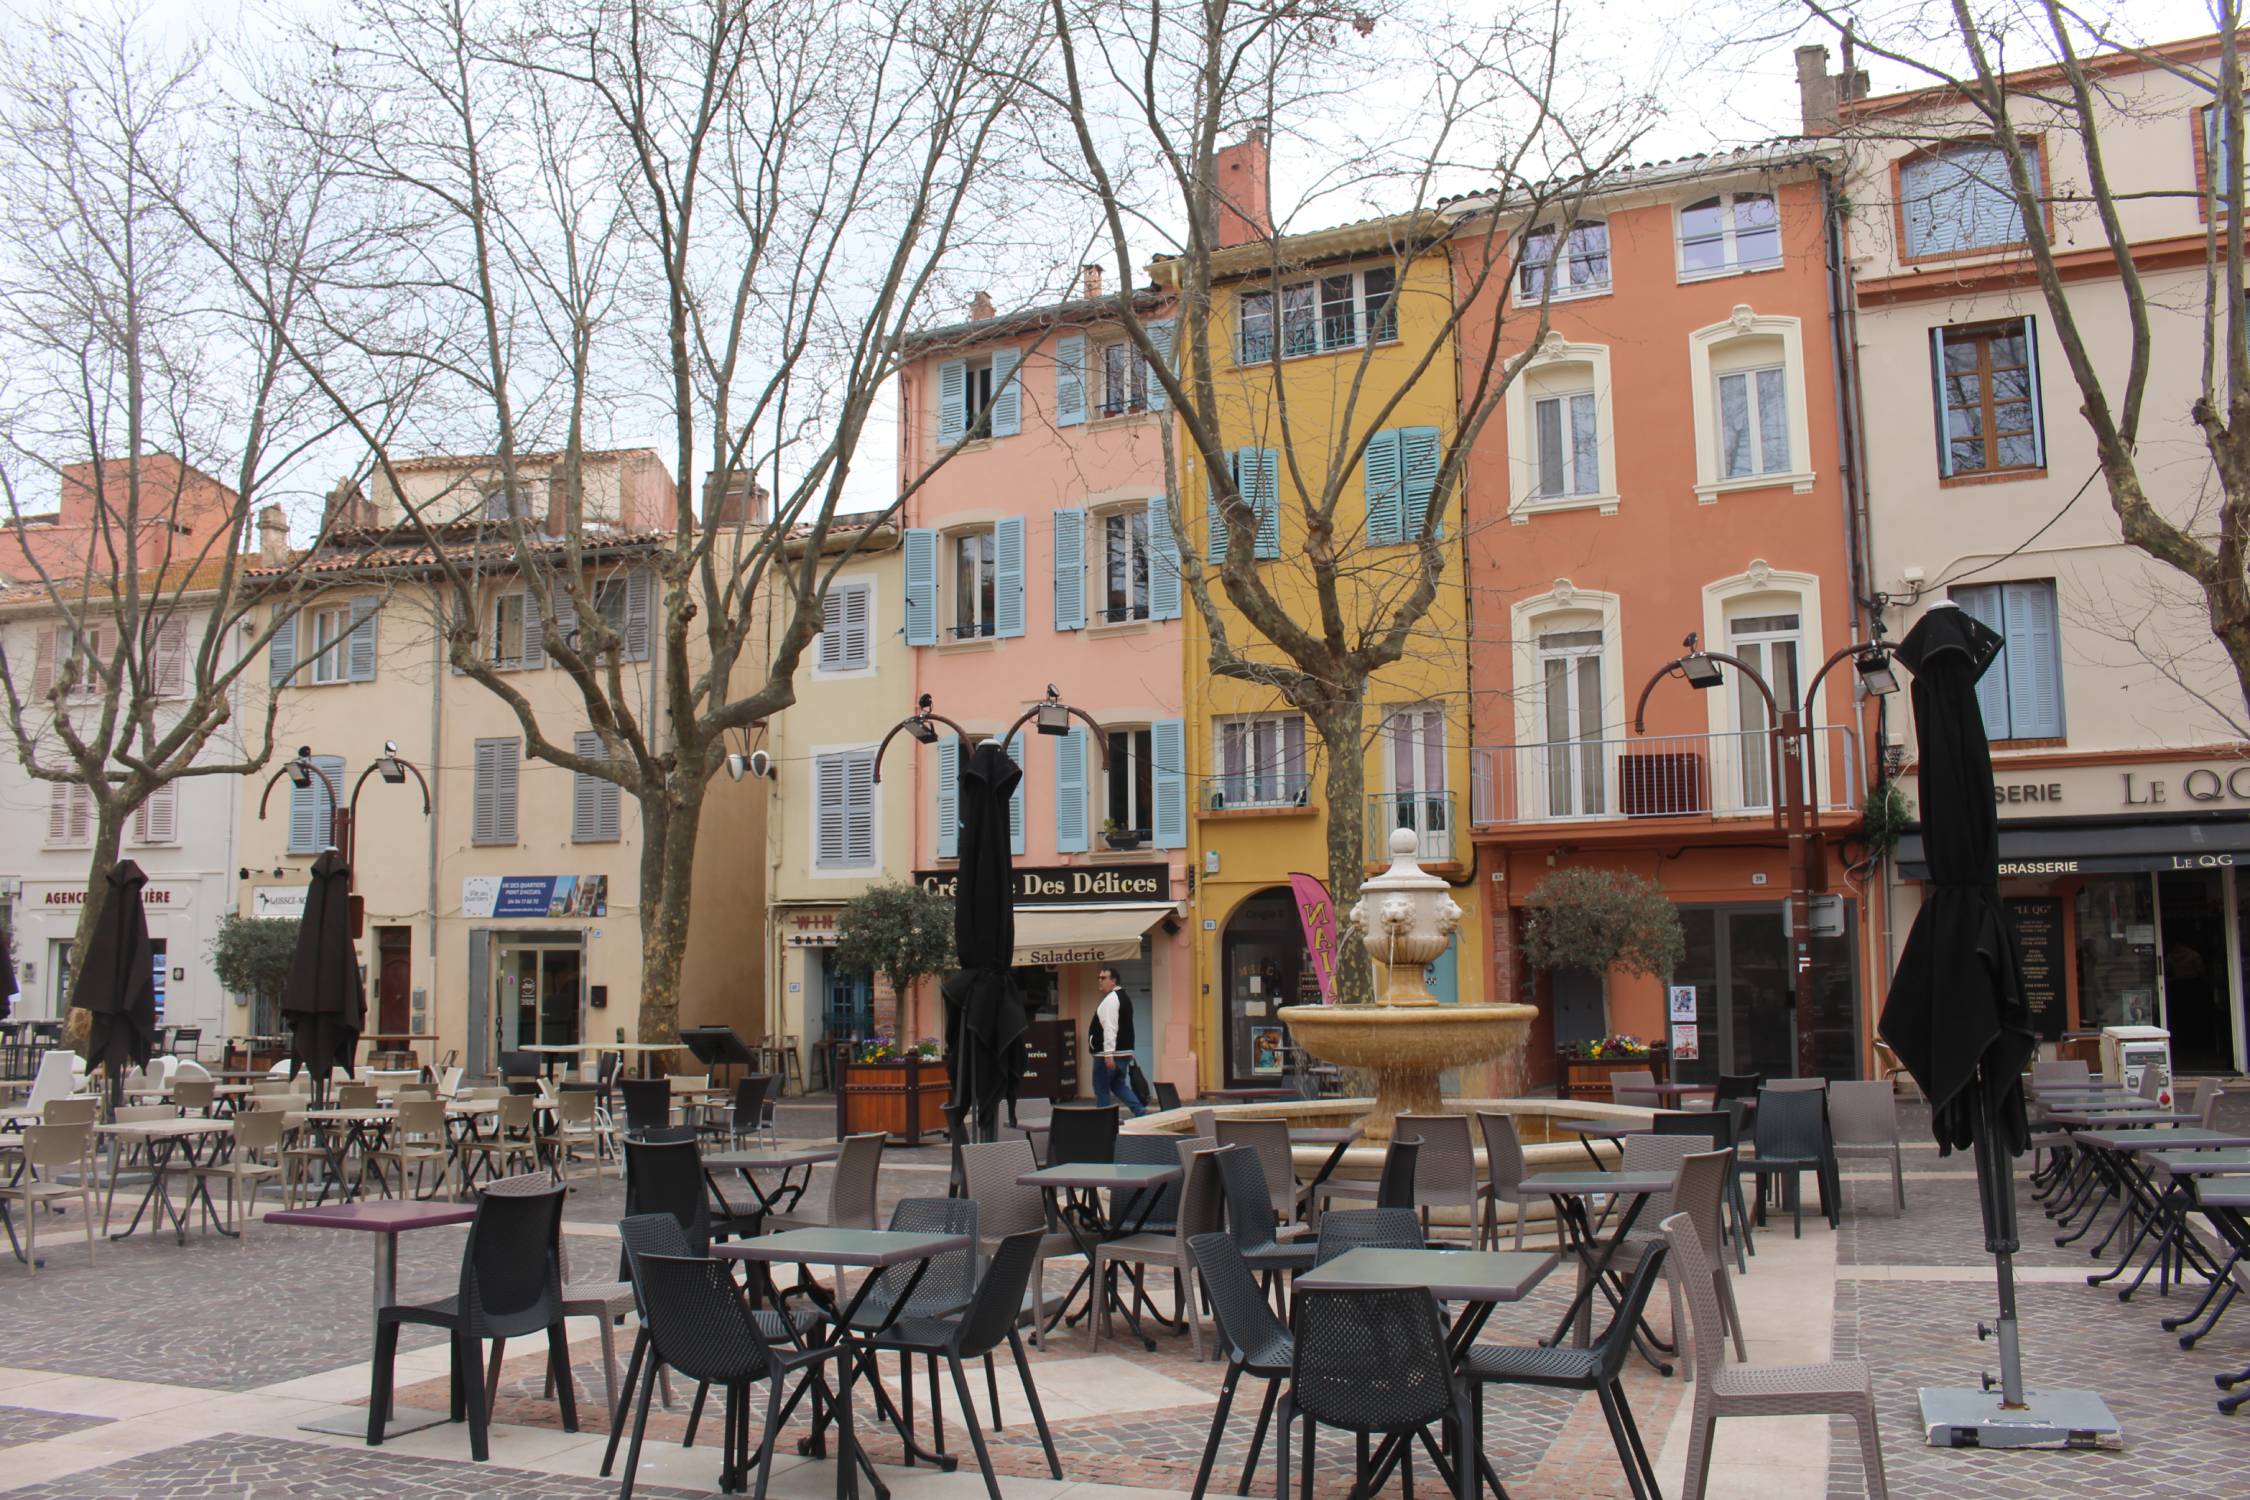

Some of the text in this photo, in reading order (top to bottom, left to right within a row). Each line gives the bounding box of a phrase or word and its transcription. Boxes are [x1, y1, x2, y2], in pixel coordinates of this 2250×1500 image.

[1994, 783, 2062, 803] SERIE
[1997, 861, 2079, 875] BRASSERIE
[2199, 854, 2233, 868] QG
[1023, 874, 1065, 896] Des
[1072, 871, 1157, 895] Délices
[796, 914, 832, 930] WIN
[795, 935, 824, 945] BAR
[1030, 947, 1105, 963] Saladerie
